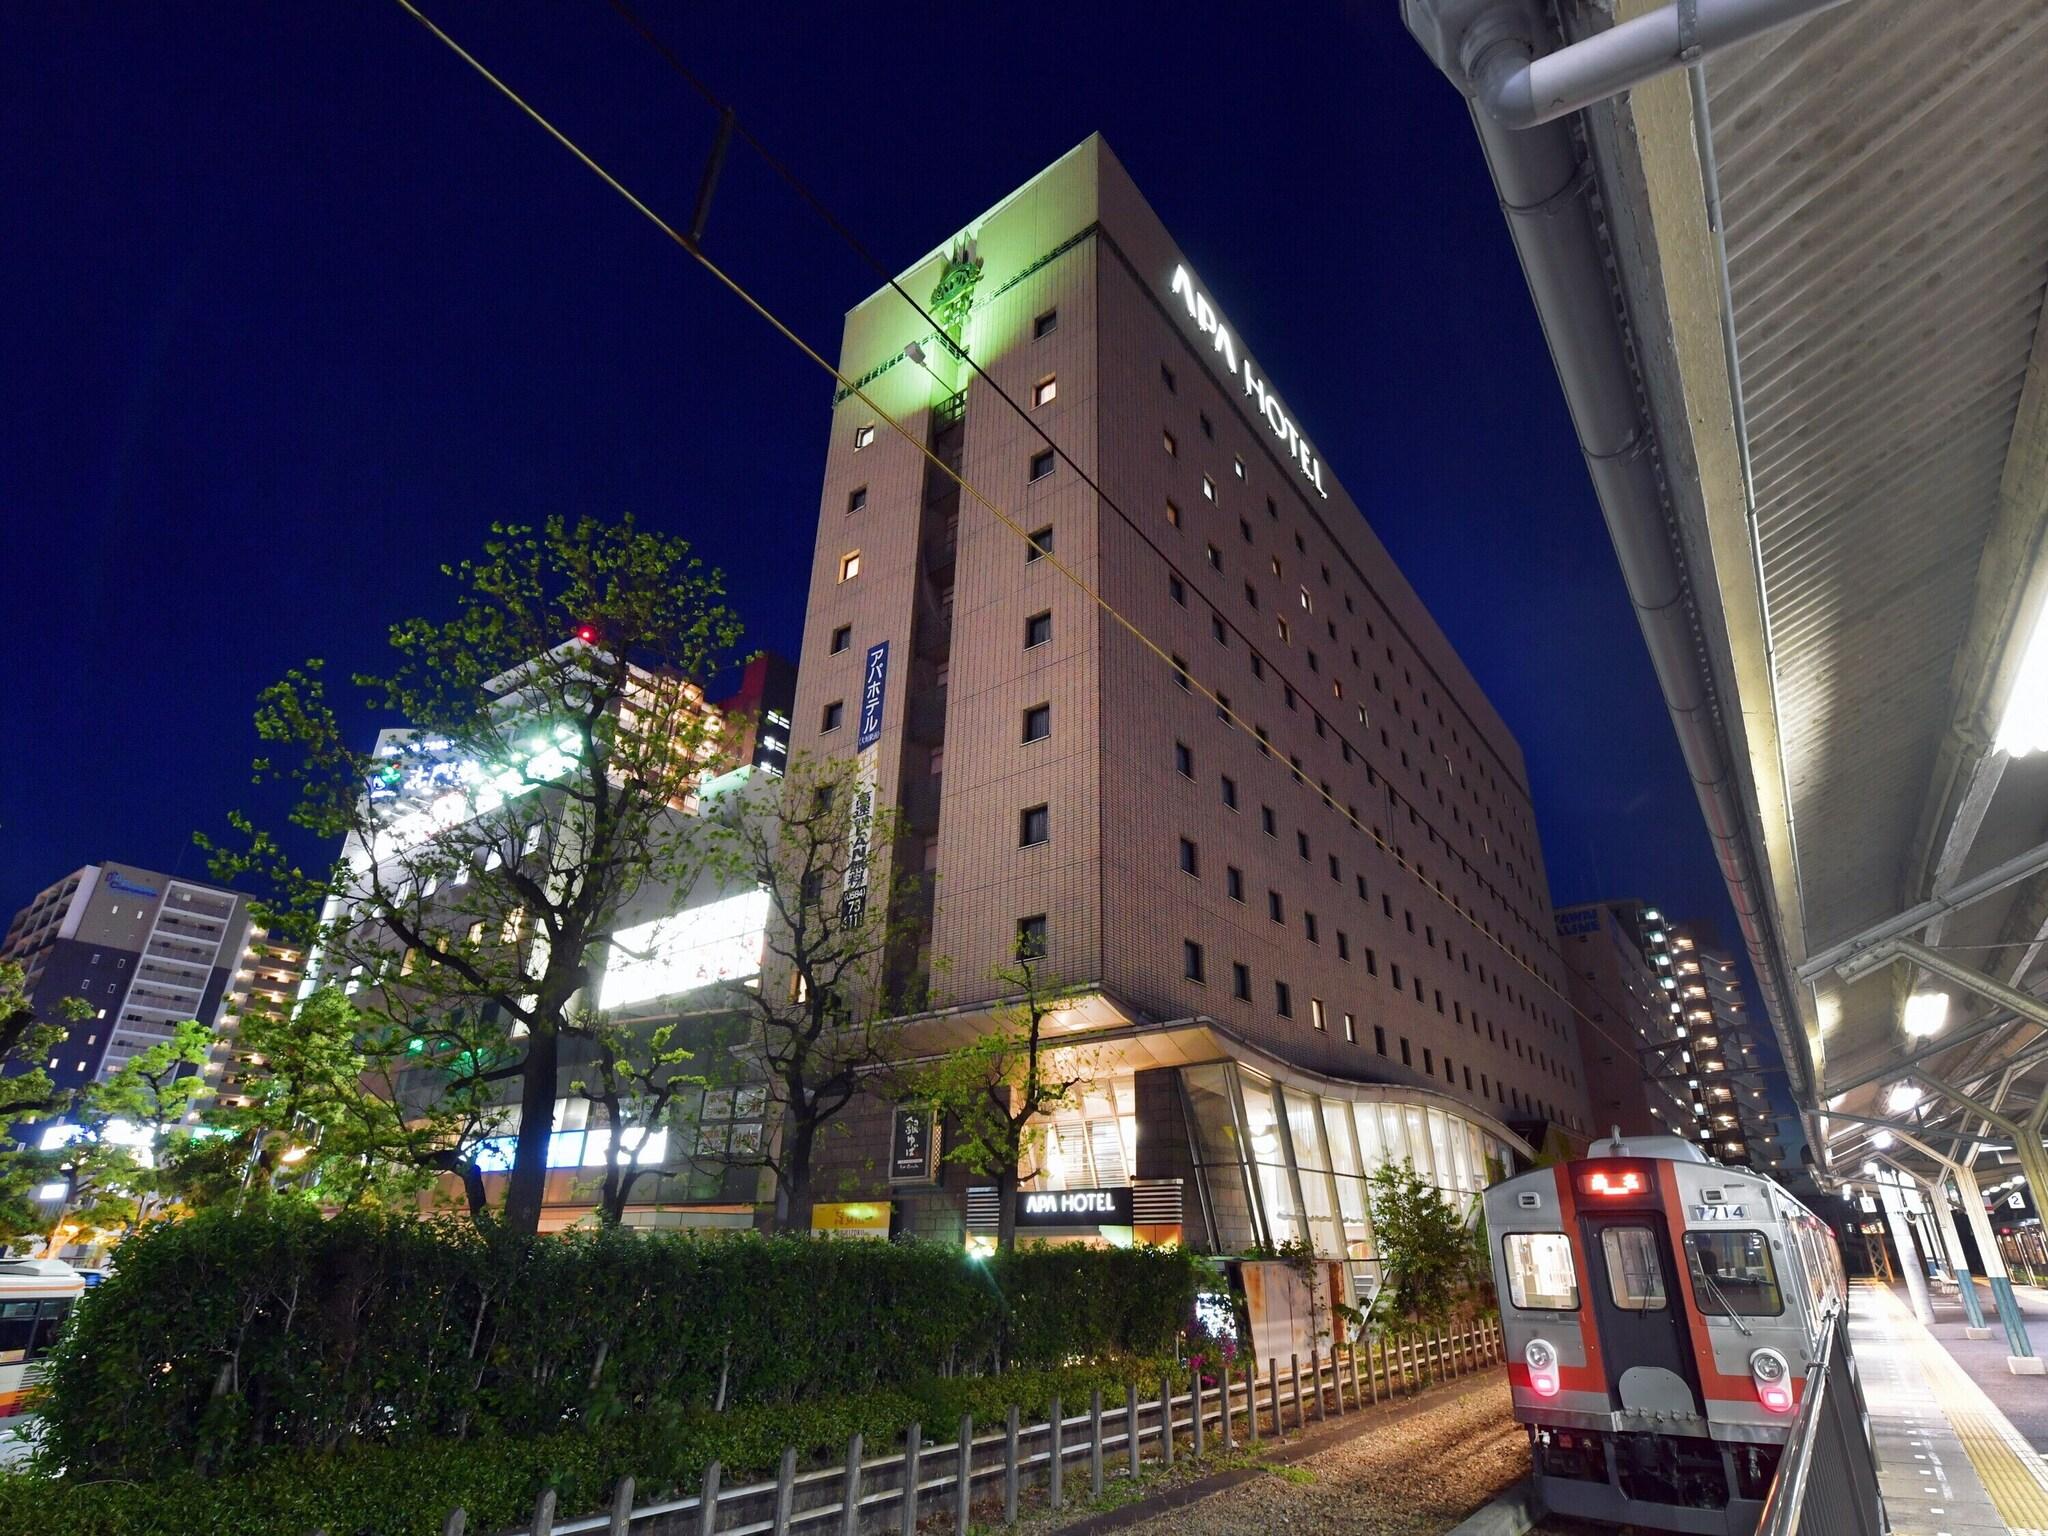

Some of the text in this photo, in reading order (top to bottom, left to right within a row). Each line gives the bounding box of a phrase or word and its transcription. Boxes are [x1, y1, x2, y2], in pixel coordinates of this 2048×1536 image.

[1171, 263, 1328, 500] APA HOTEL
[864, 648, 884, 734] アパホテル
[848, 900, 861, 915] 73
[1026, 1192, 1116, 1213] APA HOTEL
[2011, 1195, 2021, 1205] 2
[1695, 1206, 1745, 1219] 7714
